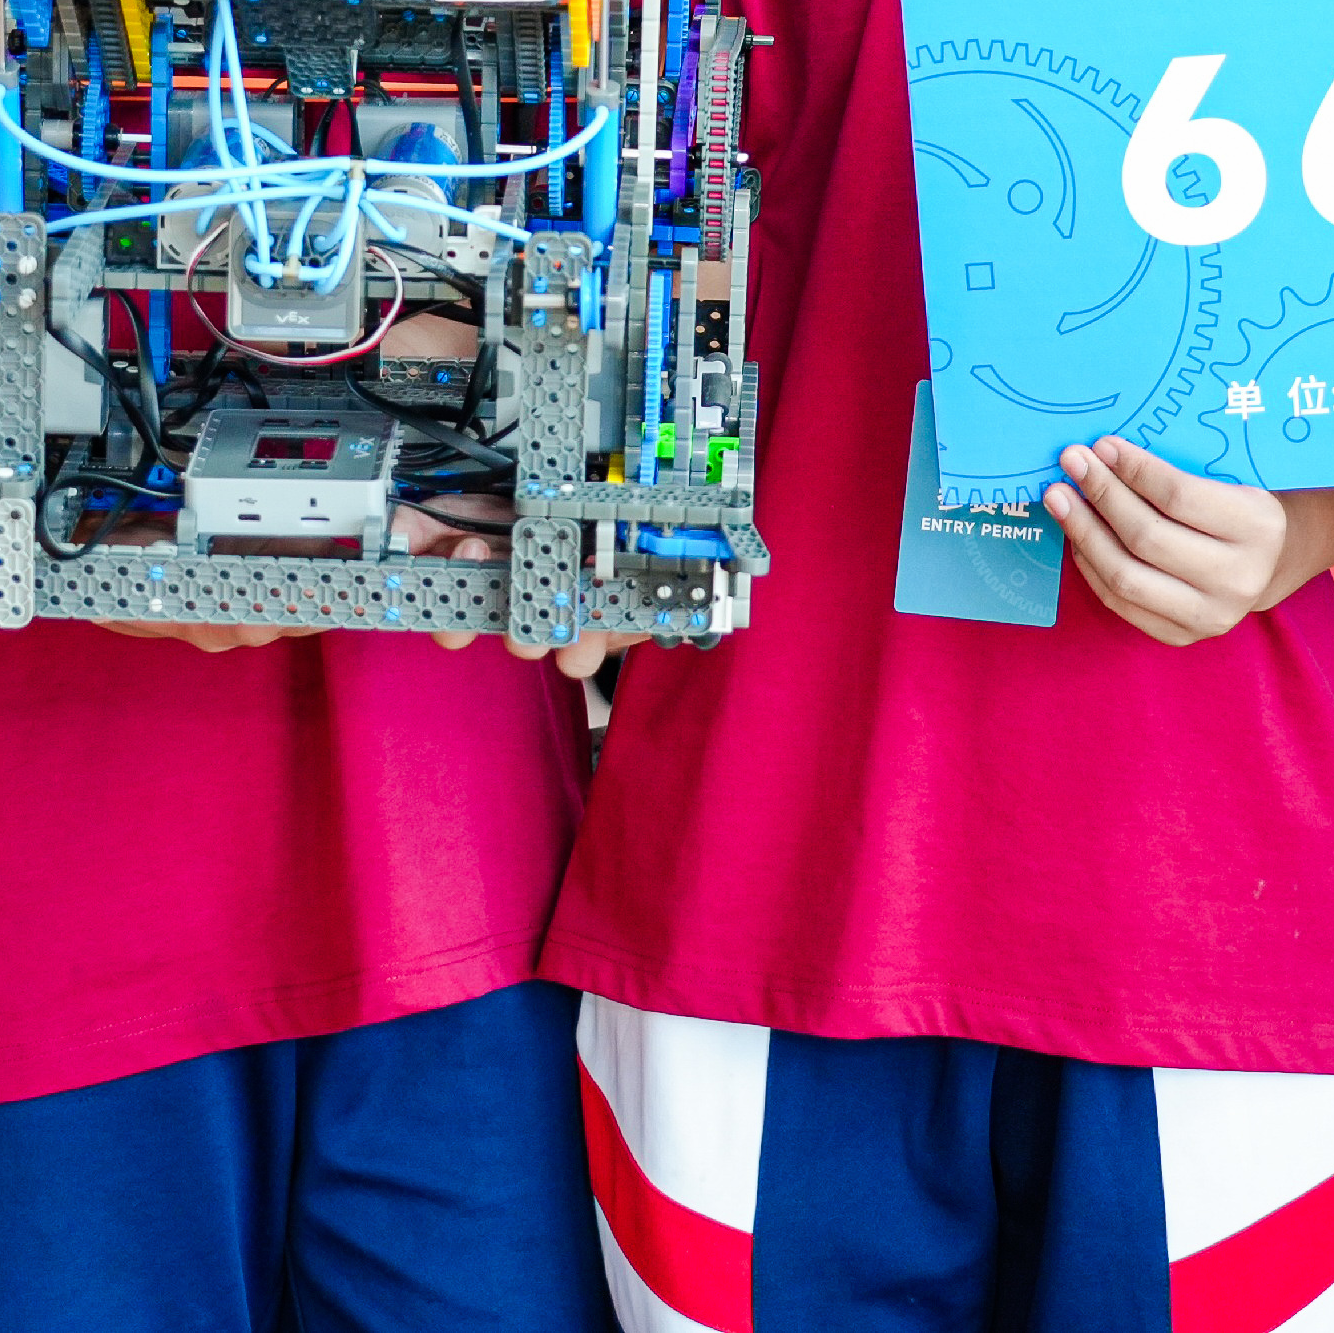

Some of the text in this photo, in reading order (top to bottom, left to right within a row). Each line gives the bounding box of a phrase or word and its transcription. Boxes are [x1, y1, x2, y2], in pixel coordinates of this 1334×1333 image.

[275, 311, 310, 325] VEX
[349, 437, 375, 459] VEX
[921, 517, 1044, 542] ENTRY PERMIT
